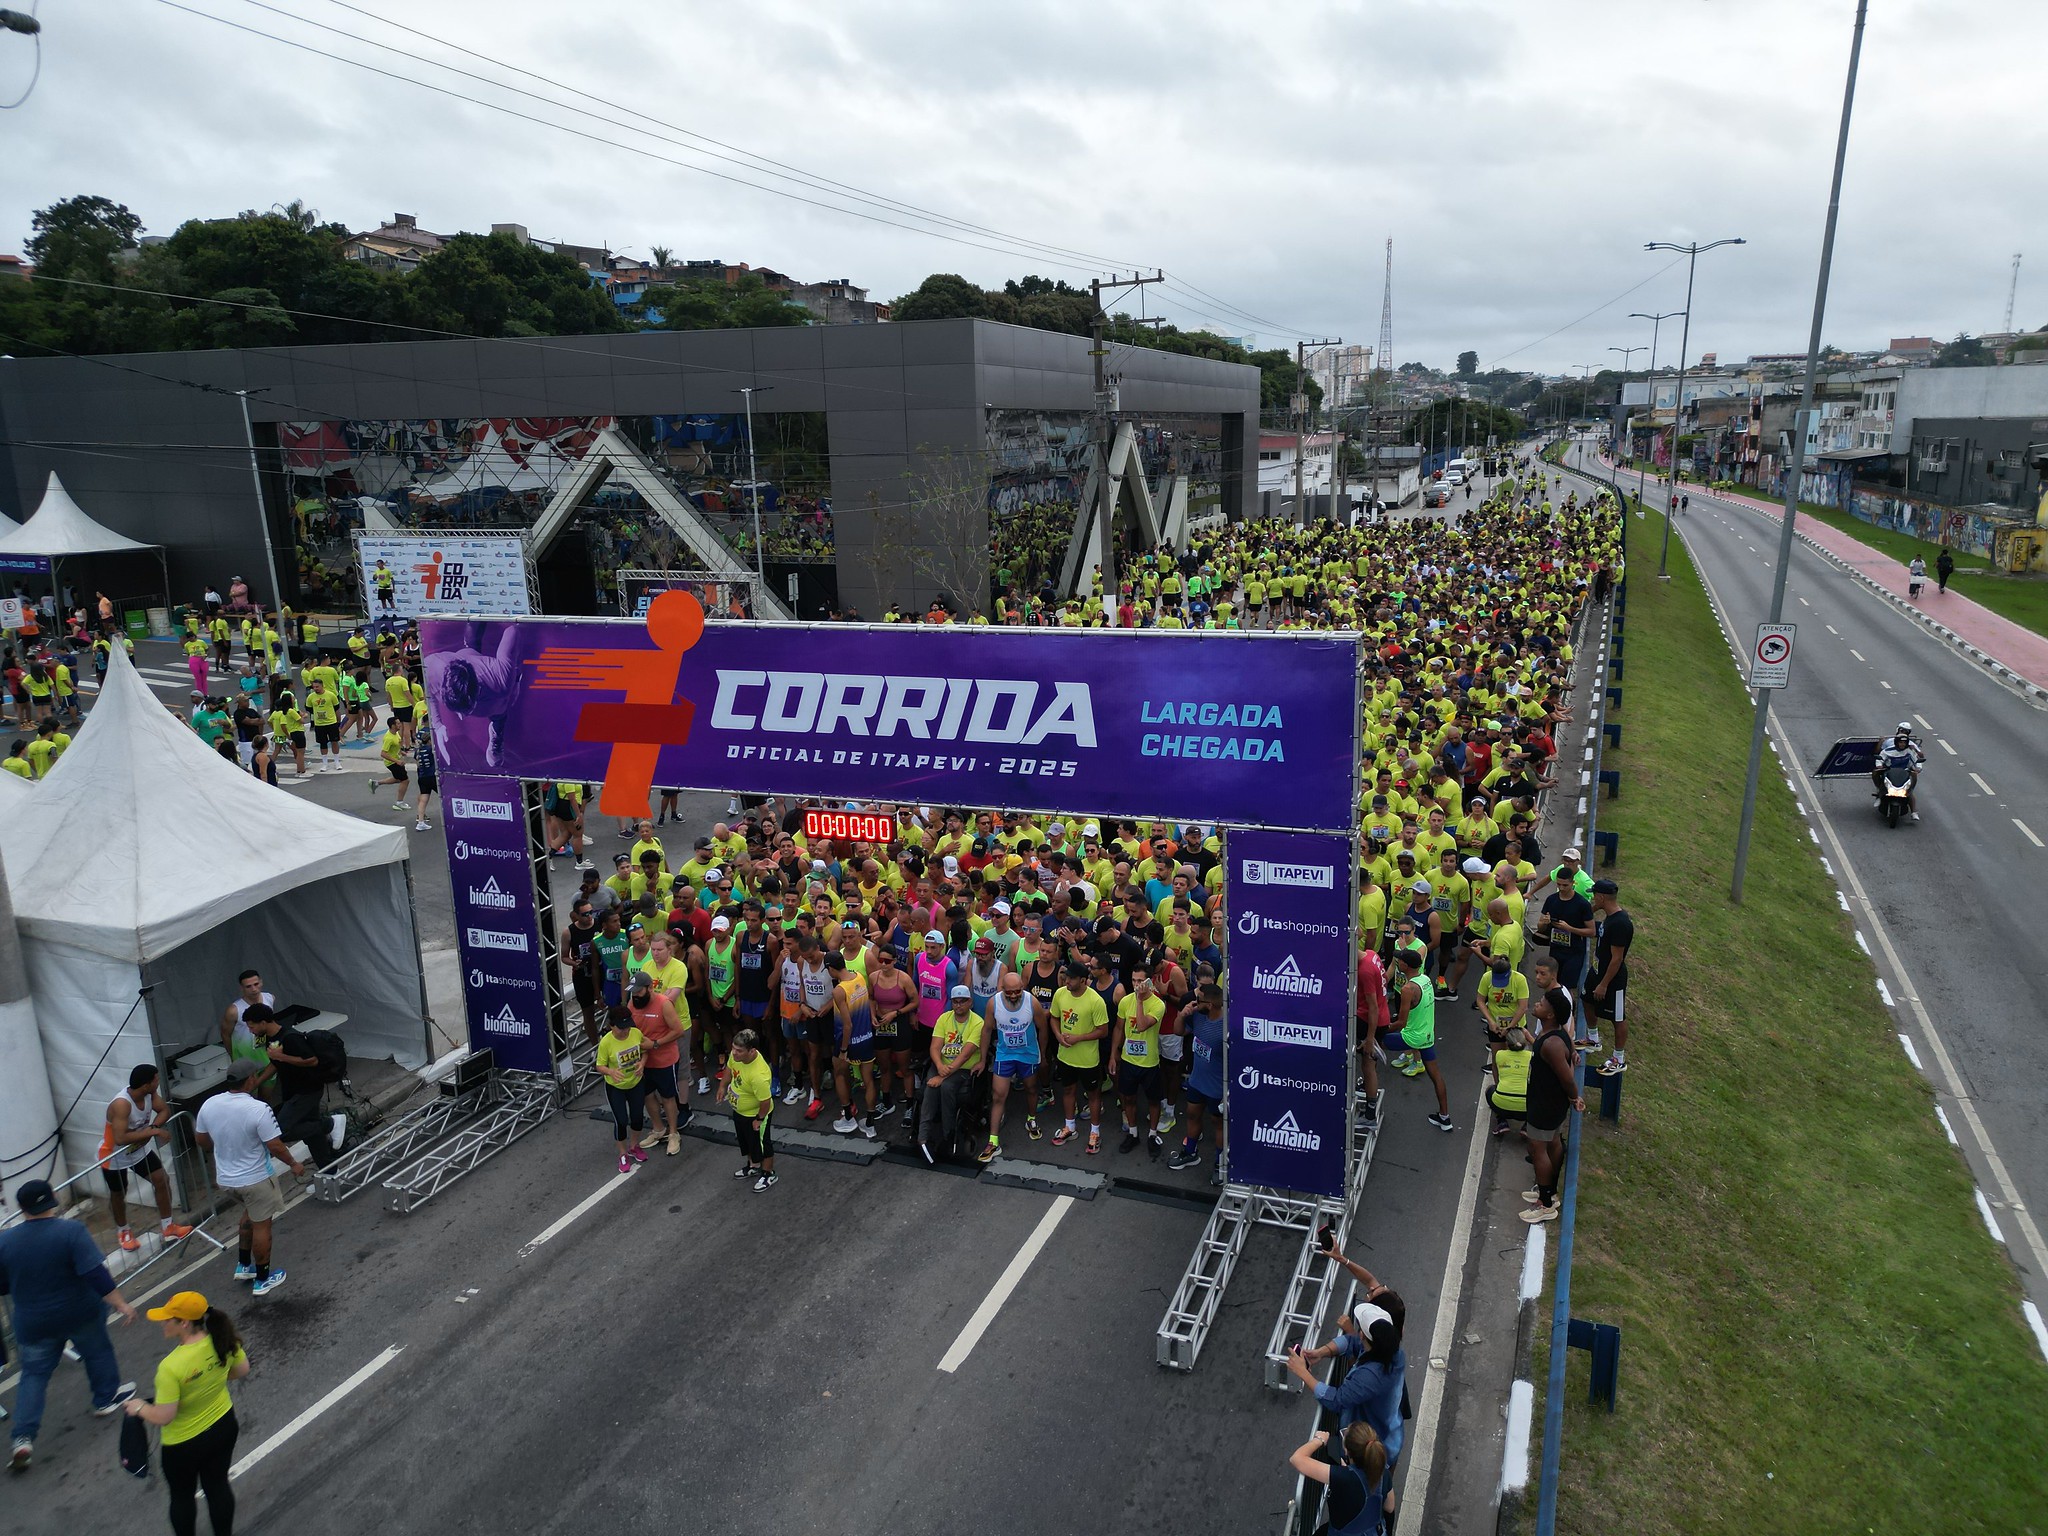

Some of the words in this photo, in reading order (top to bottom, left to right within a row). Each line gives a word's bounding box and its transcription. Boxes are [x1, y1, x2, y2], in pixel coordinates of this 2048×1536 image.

[443, 562, 464, 576] CO
[442, 575, 469, 588] RRI
[441, 587, 463, 600] DA
[710, 669, 1098, 749] CORRIDA
[1140, 700, 1283, 729] LARGADA
[1140, 733, 1285, 763] CHEGADA
[726, 744, 824, 763] OFICIAL
[832, 750, 864, 765] DE
[870, 752, 977, 772] ITAPEVI
[998, 757, 1078, 777] 2025
[472, 803, 506, 815] ITAPEVI
[806, 812, 891, 841] 00:00:00
[470, 845, 521, 861] Itashopping
[1273, 866, 1324, 881] ITAPEVI
[469, 885, 516, 909] biomania
[1435, 899, 1449, 909] 330
[1263, 917, 1339, 938] Itashopping
[487, 933, 522, 946] ITAPEVI
[601, 945, 625, 955] BRASIL
[745, 957, 758, 966] 237
[485, 974, 537, 991] Itashopping
[1252, 965, 1323, 995] biomania
[483, 1012, 531, 1036] biomania
[1008, 1035, 1024, 1045] 675
[1273, 1025, 1323, 1041] ITAPEVI
[1129, 1043, 1144, 1053] 439
[620, 1050, 640, 1063] 1144
[1262, 1073, 1337, 1097] Itashopping
[1252, 1119, 1321, 1151] biomania
